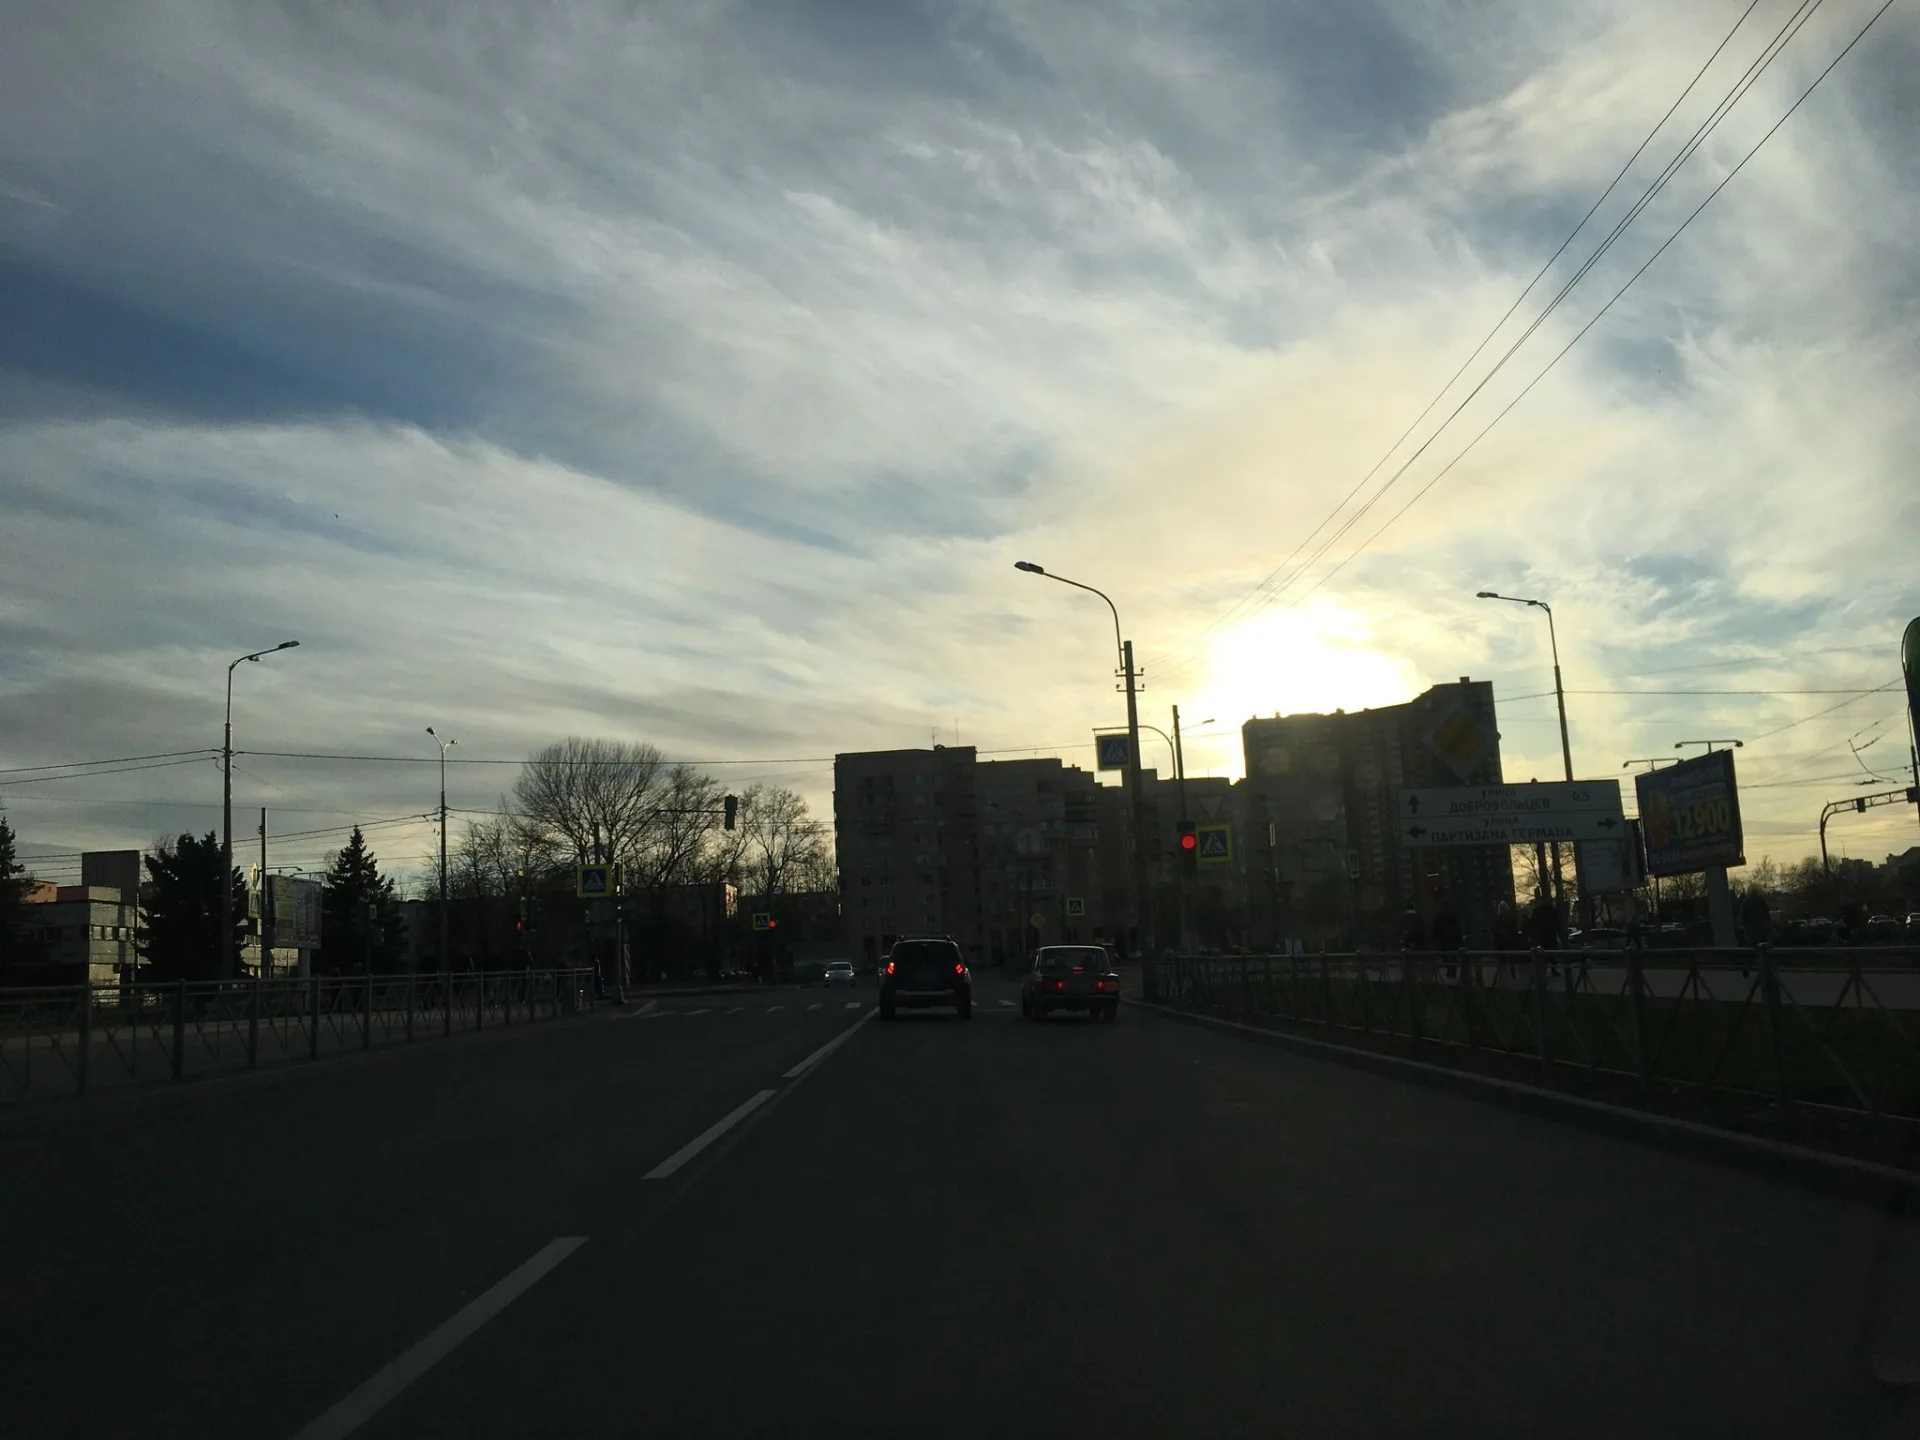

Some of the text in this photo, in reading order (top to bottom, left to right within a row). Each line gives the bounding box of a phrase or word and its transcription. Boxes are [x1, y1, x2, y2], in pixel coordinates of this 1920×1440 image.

[1449, 798, 1550, 814] ДОБРОВОЛЬЦЕВ
[1432, 826, 1573, 844] ПАРТИЗАНА ГЕРМАНА
